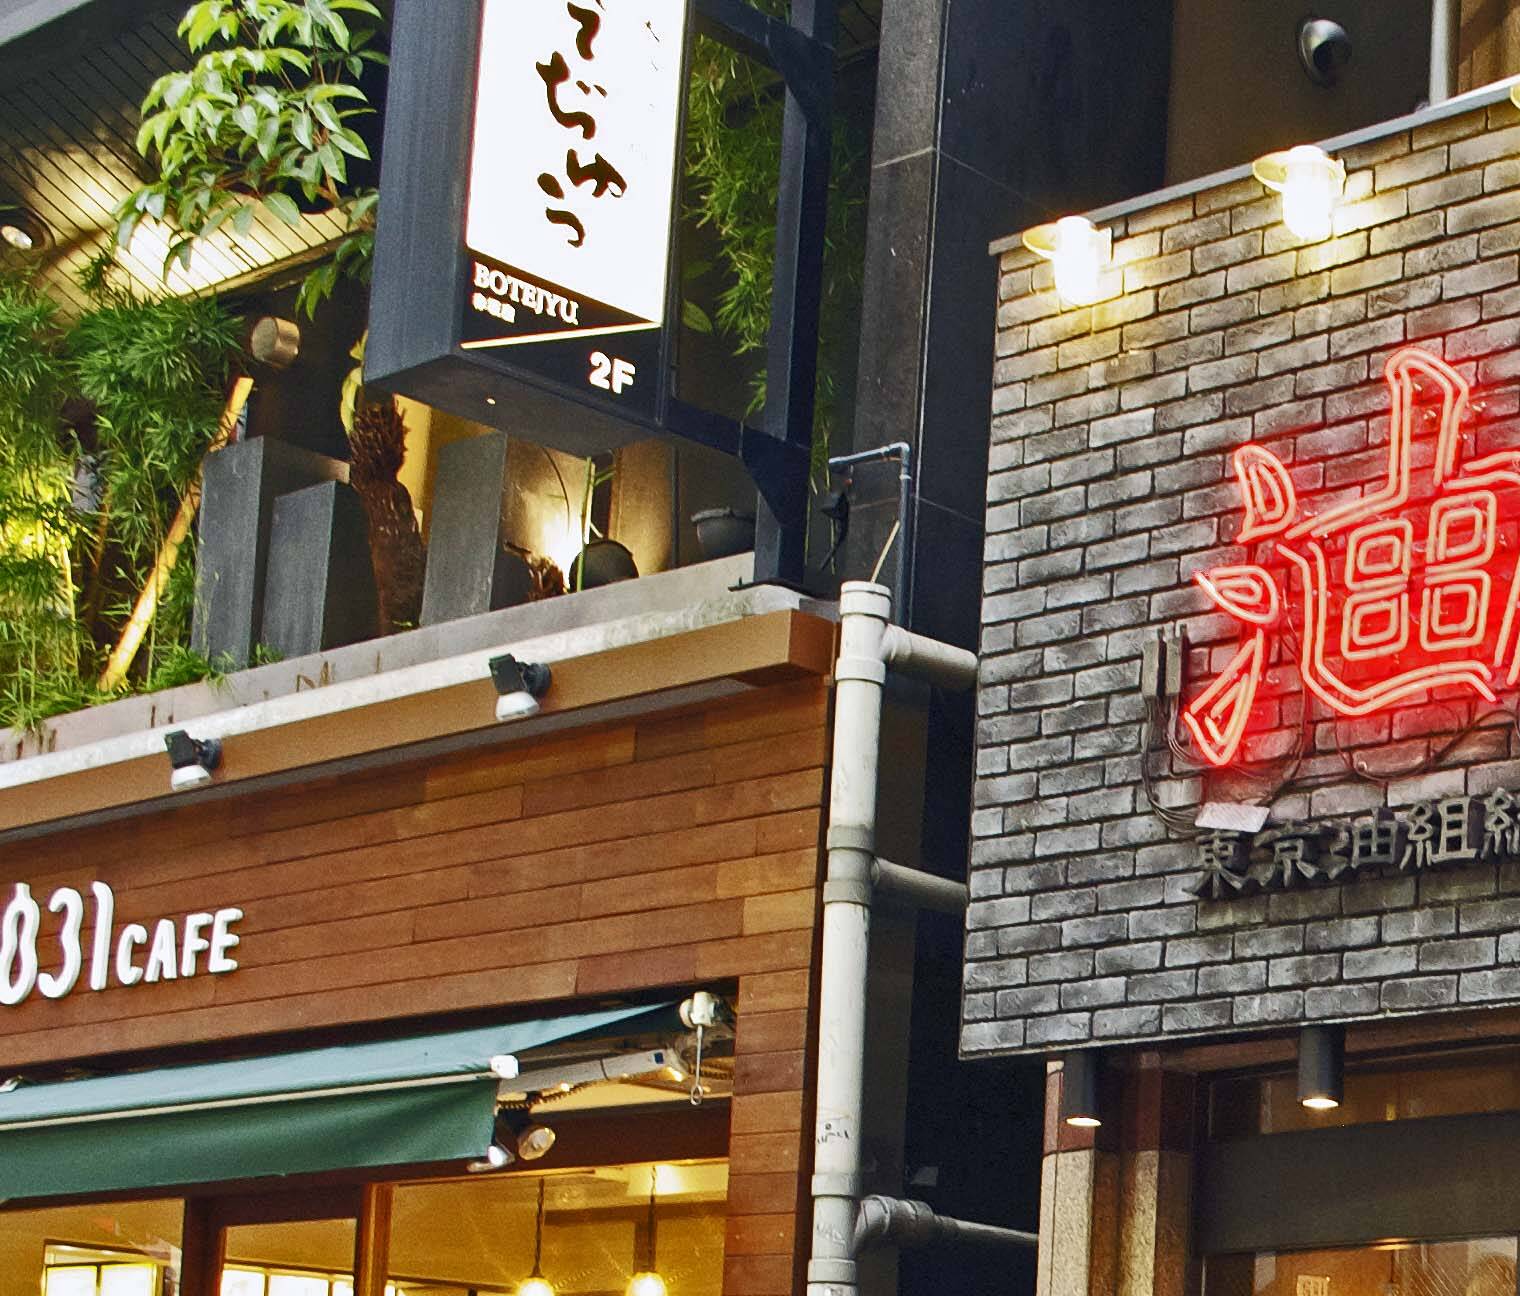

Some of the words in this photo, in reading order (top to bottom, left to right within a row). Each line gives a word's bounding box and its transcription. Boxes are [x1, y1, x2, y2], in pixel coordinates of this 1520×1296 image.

[474, 261, 579, 326] BOTEJYU
[589, 351, 636, 394] 2F
[116, 907, 244, 986] CAFE
